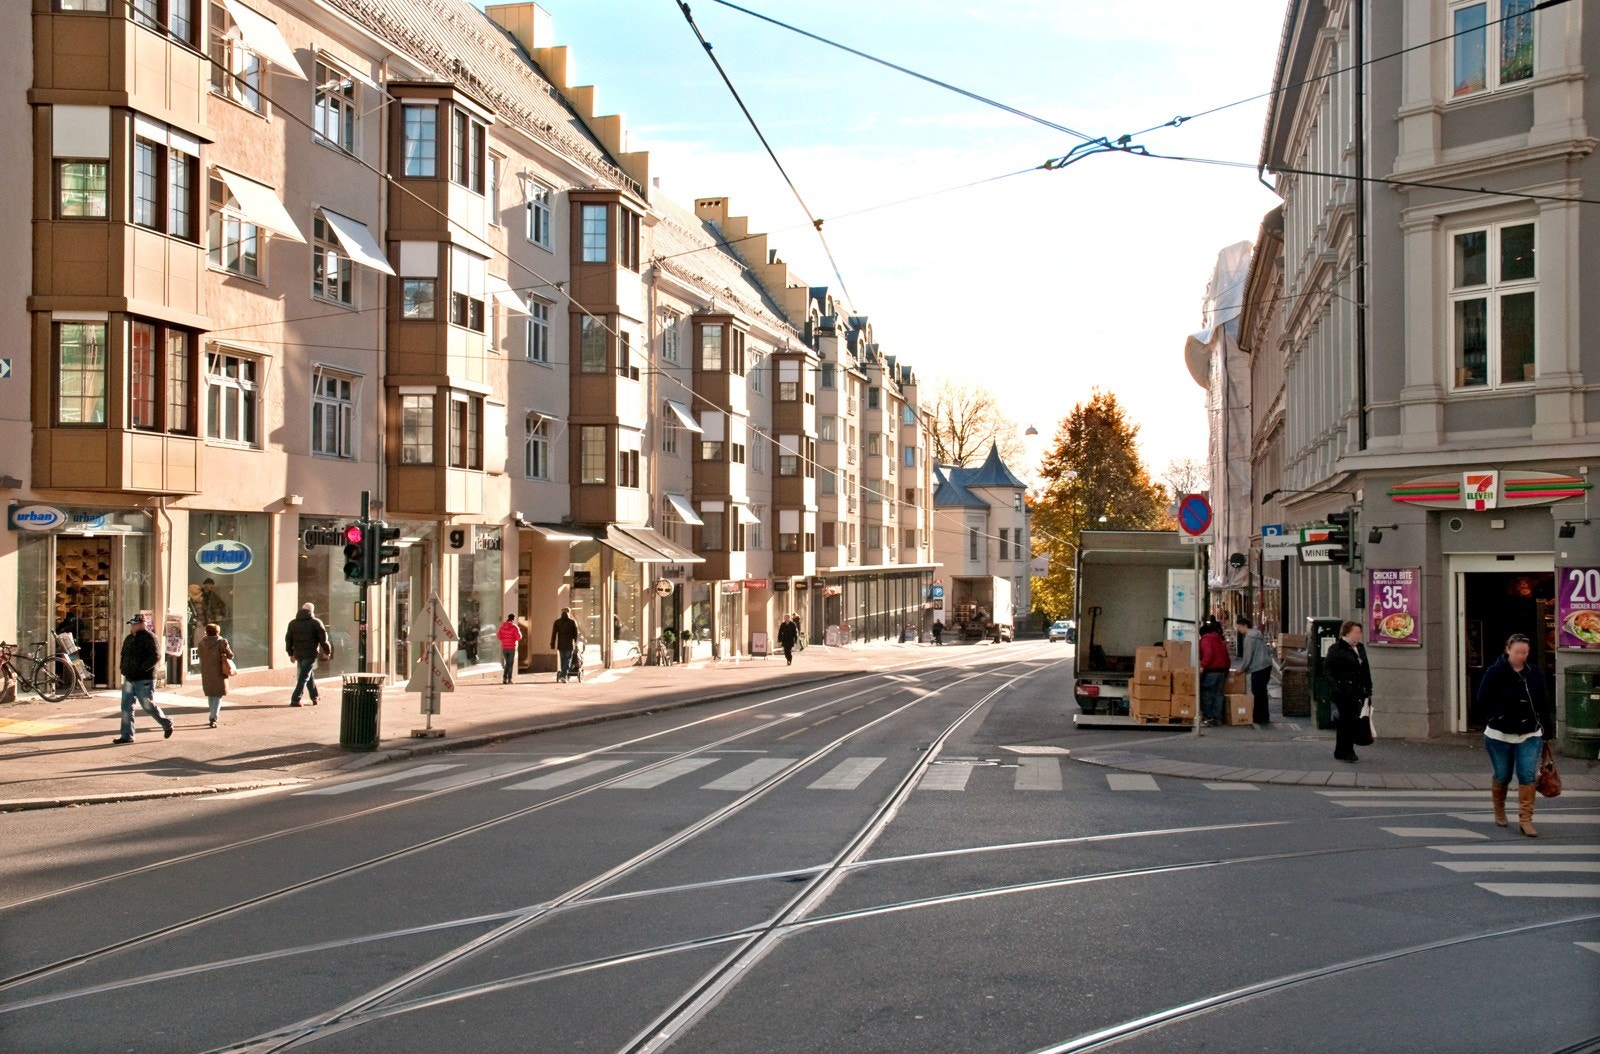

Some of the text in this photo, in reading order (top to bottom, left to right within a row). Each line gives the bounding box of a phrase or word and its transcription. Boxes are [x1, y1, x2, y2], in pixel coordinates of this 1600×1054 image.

[1467, 475, 1493, 511] 7
[17, 511, 52, 521] urban
[450, 530, 464, 549] g
[201, 544, 246, 564] urban
[1373, 571, 1413, 580] CHICKEN BITE
